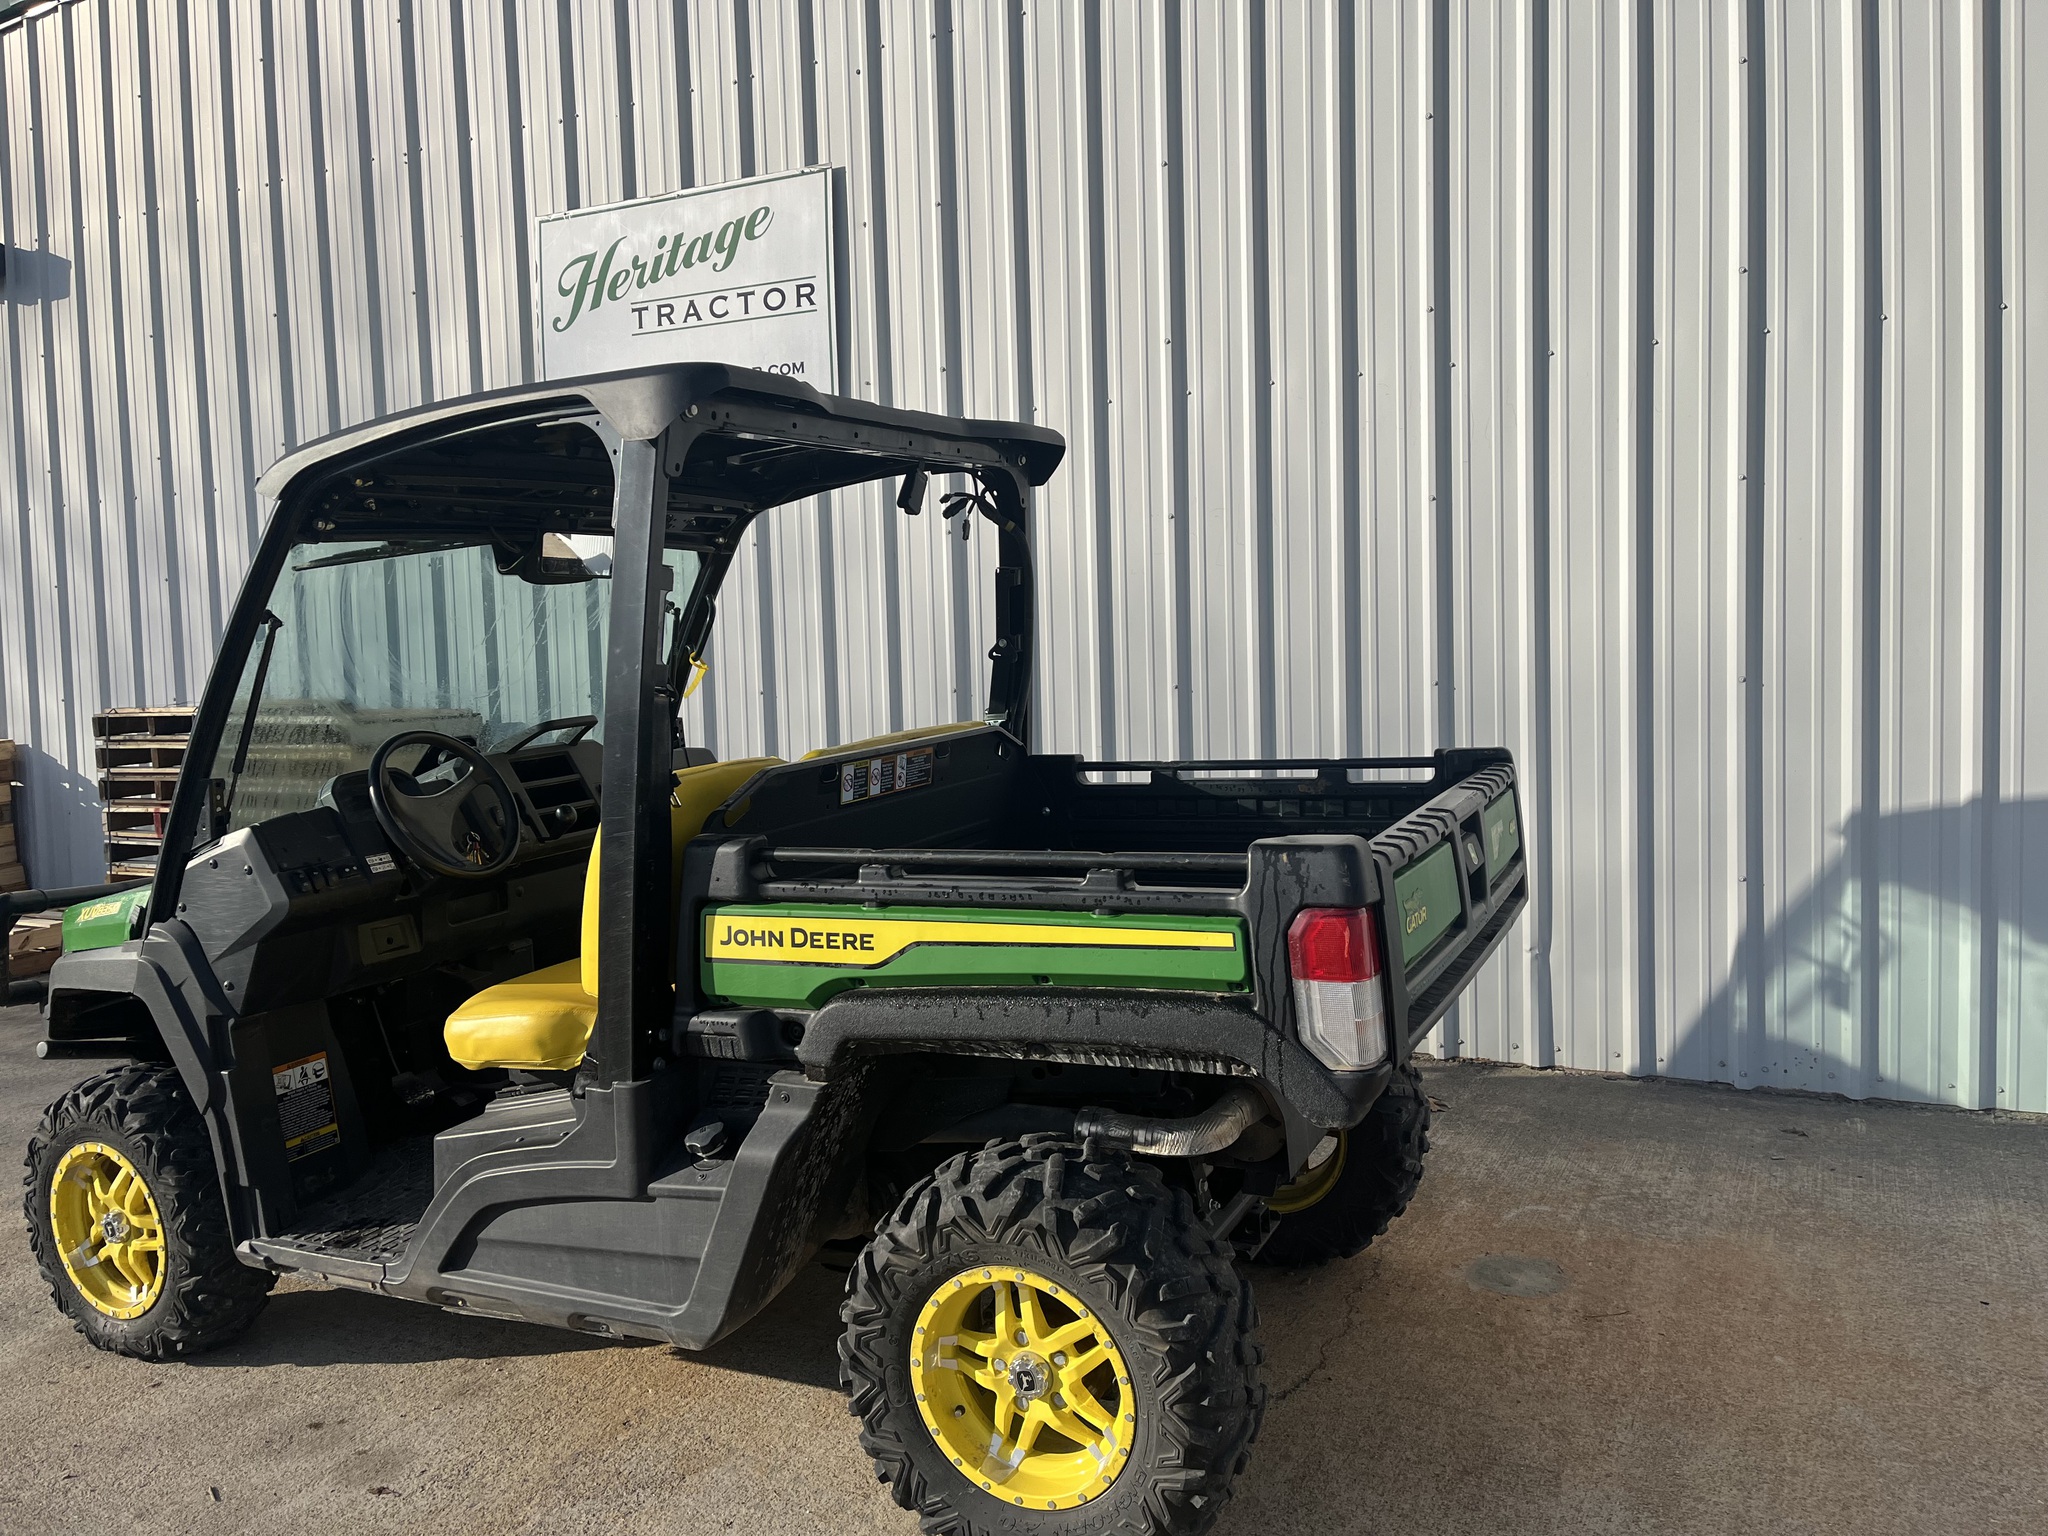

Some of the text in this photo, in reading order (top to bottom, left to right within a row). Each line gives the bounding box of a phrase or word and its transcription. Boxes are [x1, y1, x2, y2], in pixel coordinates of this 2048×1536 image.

[552, 206, 775, 333] Heritage
[631, 283, 816, 329] TRACTOR
[720, 925, 875, 951] JOHN DEERE
[1406, 905, 1427, 934] GATOR
